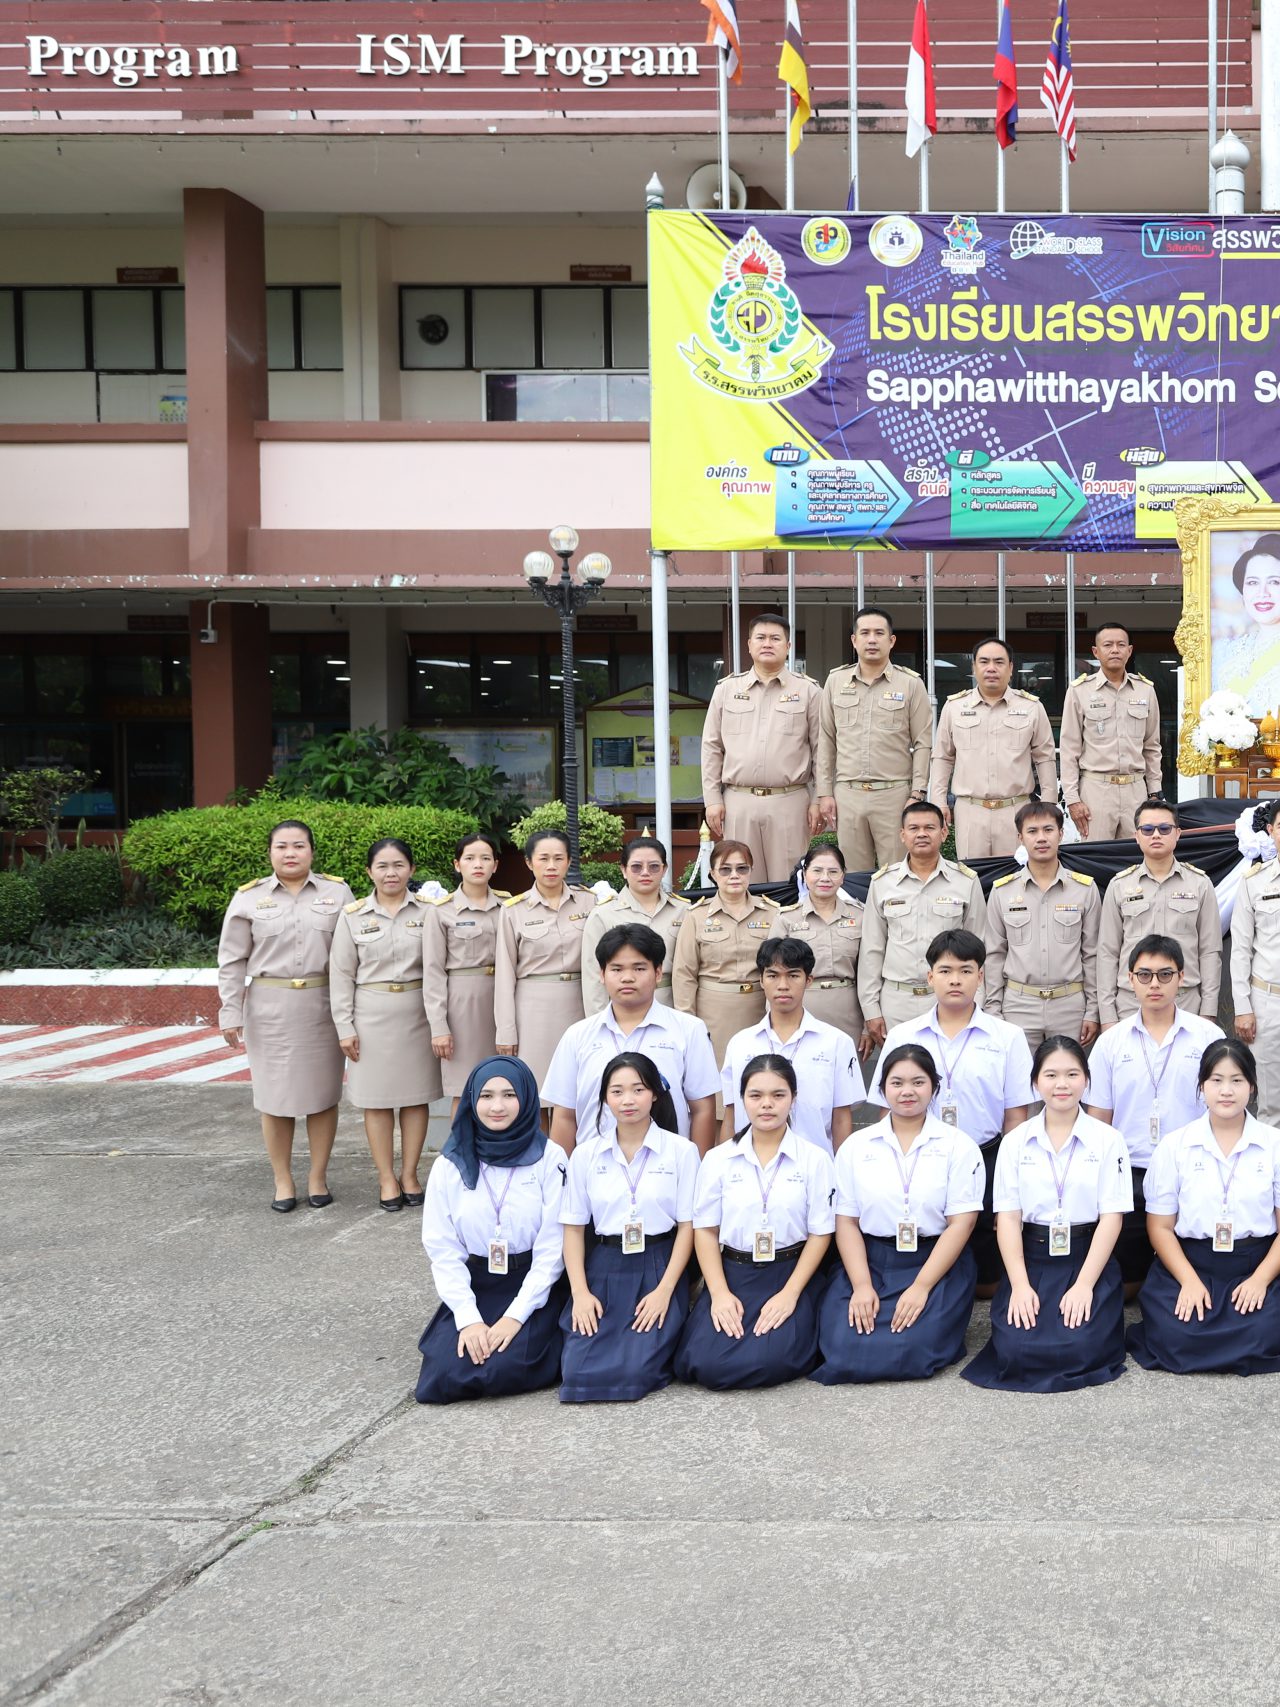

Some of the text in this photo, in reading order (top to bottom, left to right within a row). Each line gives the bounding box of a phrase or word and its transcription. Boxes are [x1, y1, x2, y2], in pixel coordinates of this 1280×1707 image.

[26, 35, 238, 86] Program
[356, 33, 700, 85] ISM Program
[1146, 227, 1206, 252] Vision
[944, 252, 984, 260] Thailand
[866, 370, 1236, 412] Sapphawitthayakhom
[706, 460, 748, 478] องค์กร
[905, 460, 938, 480] สร้าง
[721, 481, 771, 498] คุณภาพ
[919, 481, 948, 495] คนดี
[1084, 480, 1136, 498] ความสุข
